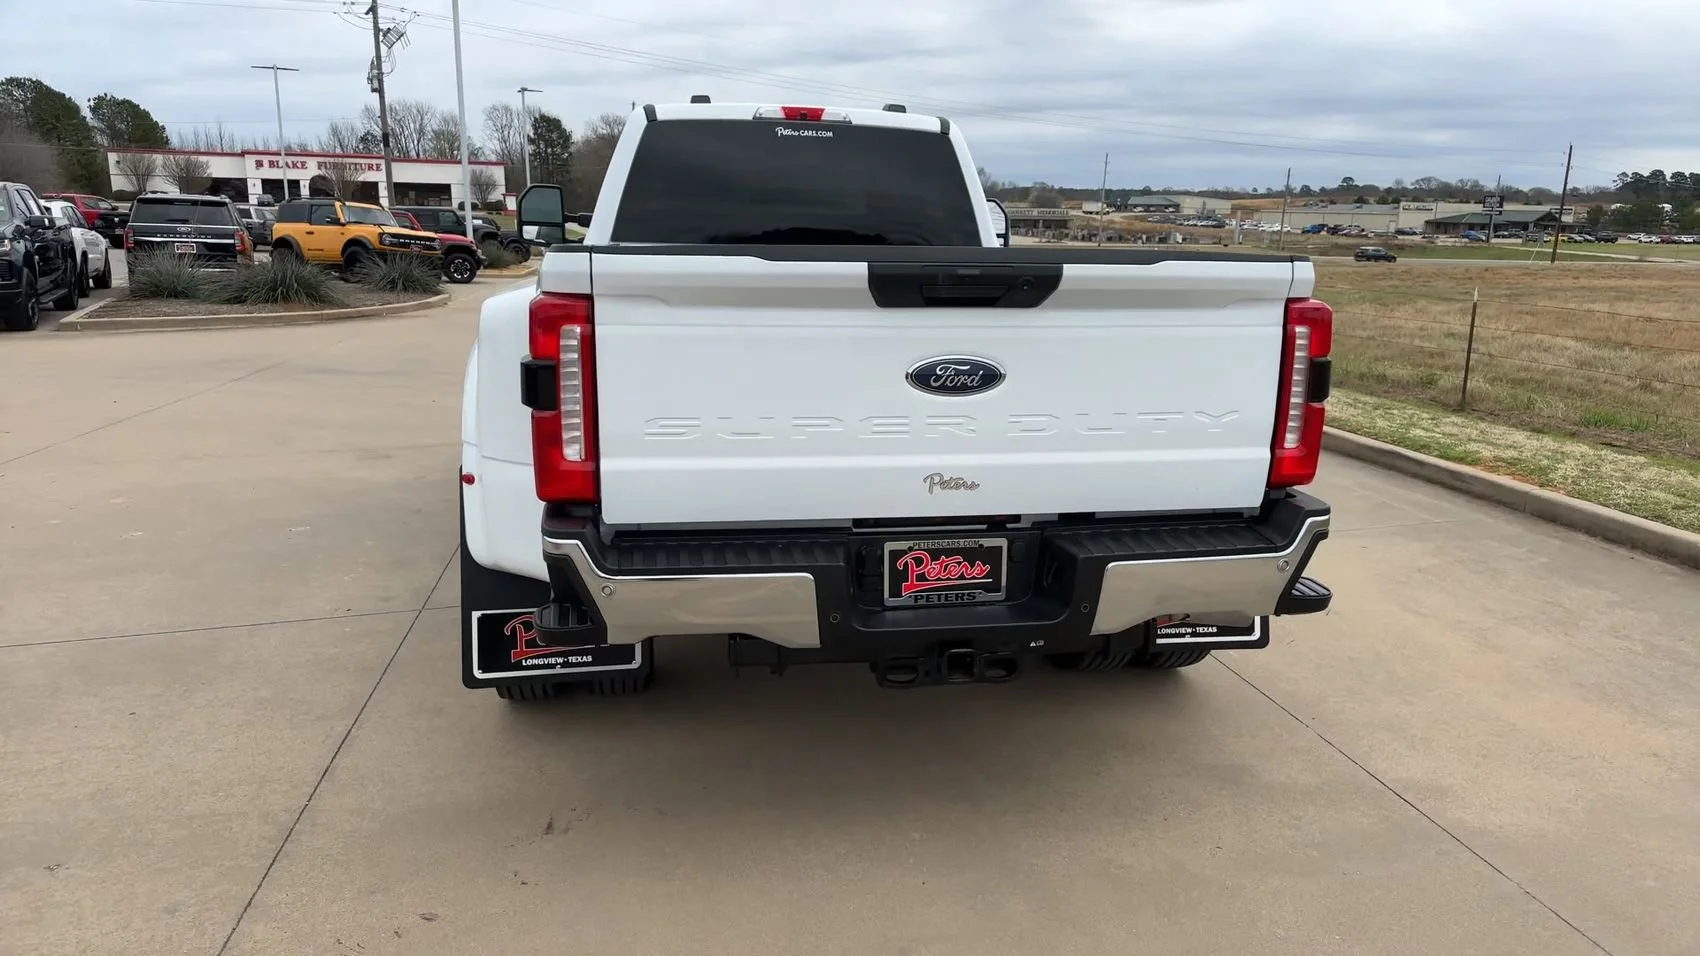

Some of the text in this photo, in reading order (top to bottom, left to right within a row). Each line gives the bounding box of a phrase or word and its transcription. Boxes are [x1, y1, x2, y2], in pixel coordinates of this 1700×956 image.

[268, 160, 308, 170] BLAKE
[316, 161, 383, 172] FURNITURE
[930, 364, 984, 387] Ford
[644, 410, 1240, 440] SUPER DUTY
[923, 472, 981, 495] Peters
[912, 540, 981, 549] PETERSCARS.COM
[897, 551, 991, 588] Peters
[1157, 627, 1193, 635] LONGVIEW
[522, 655, 593, 666] LONGVIEW TEXAS
